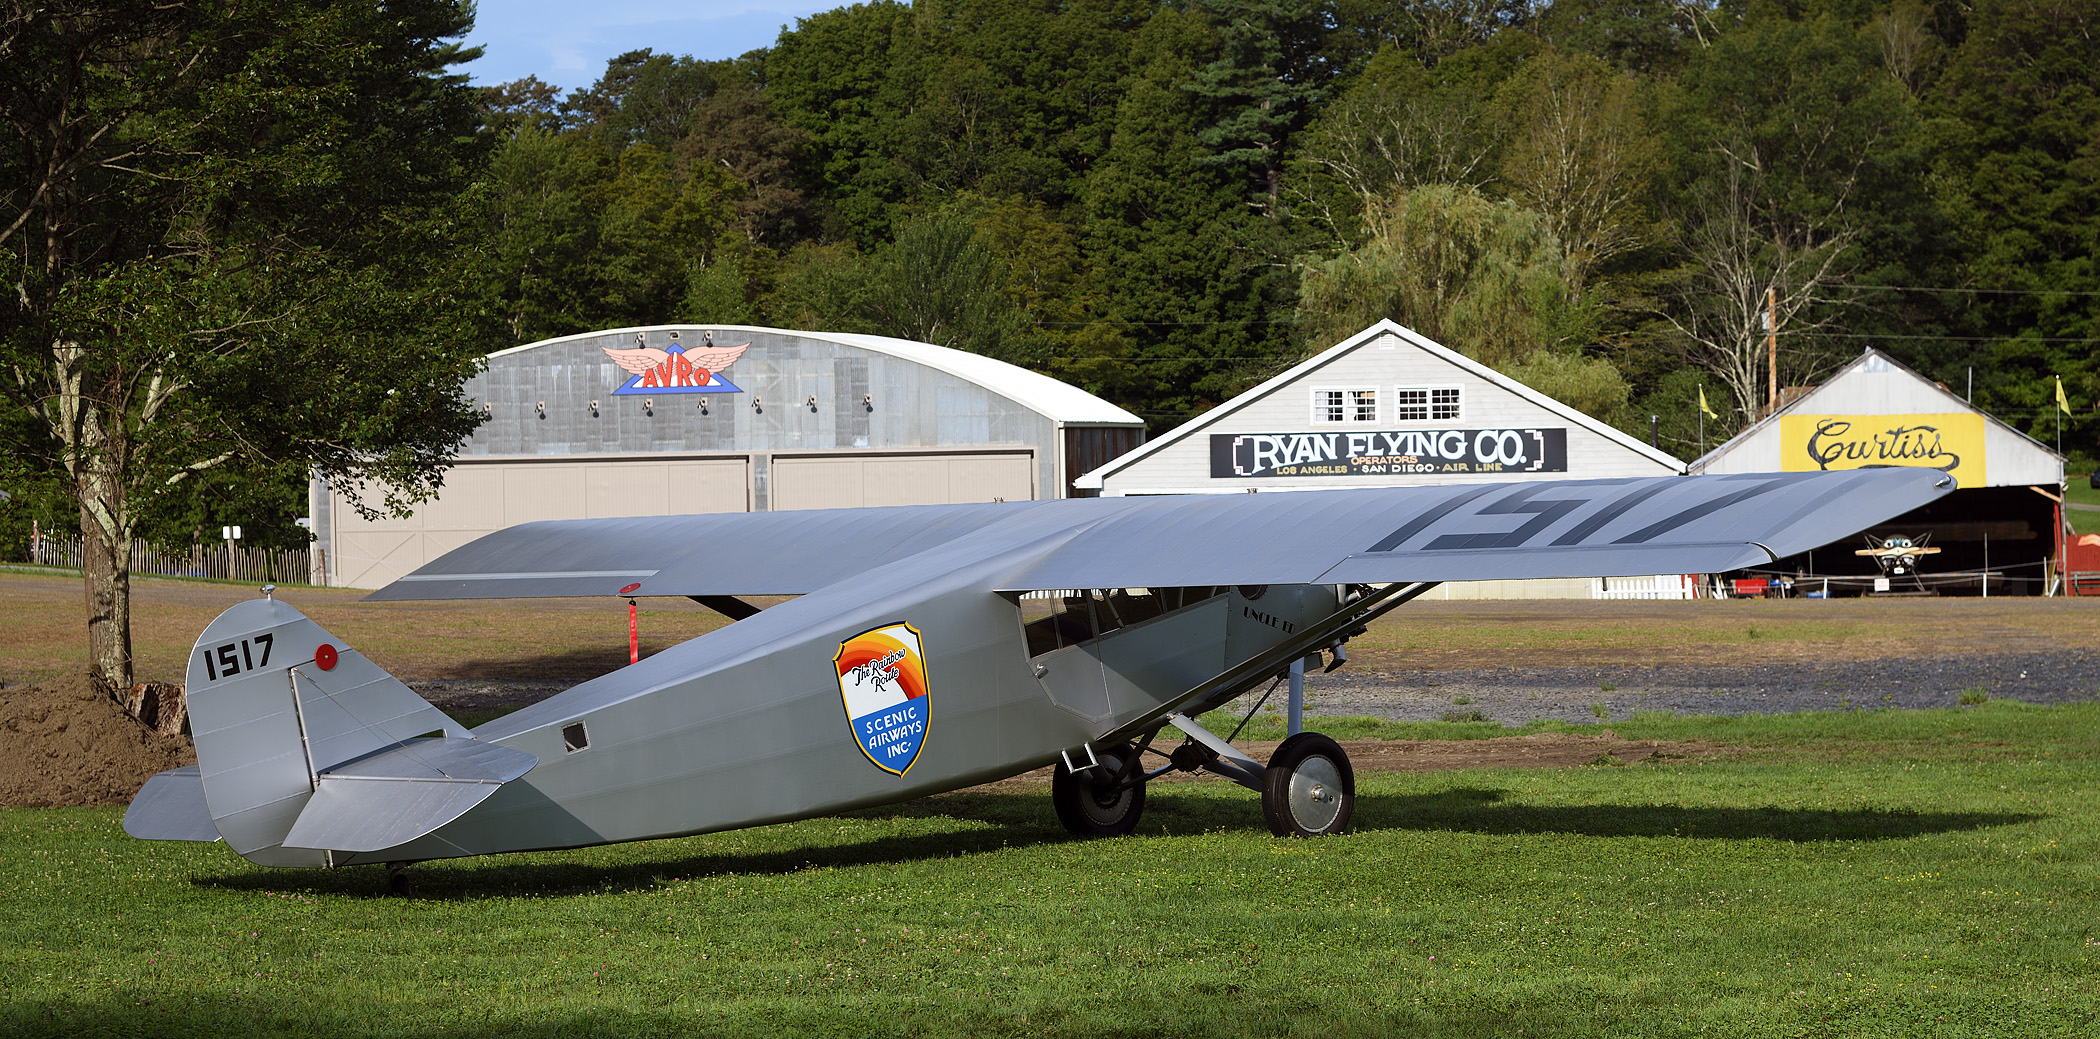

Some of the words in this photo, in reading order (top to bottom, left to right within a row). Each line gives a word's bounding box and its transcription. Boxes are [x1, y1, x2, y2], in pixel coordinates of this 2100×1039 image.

[642, 352, 711, 388] AVRO
[1252, 434, 1340, 474] RYAN
[1345, 431, 1468, 460] FLYING
[1474, 429, 1527, 466] CO.
[1350, 456, 1418, 465] OPERATORS
[1807, 418, 1960, 472] Curtiss
[1276, 466, 1297, 475] LOS
[1300, 465, 1348, 474] ANGELES
[1361, 464, 1387, 473] SAN
[1391, 463, 1435, 473] DIEGO
[1442, 463, 1469, 472] AIR
[1475, 462, 1503, 472] LINE
[1365, 471, 1822, 553] 1517
[1243, 606, 1279, 629] UNCLE
[1282, 620, 1296, 634] ED
[203, 632, 273, 681] 1517
[851, 664, 871, 686] The
[869, 648, 906, 677] Rainbow
[870, 667, 899, 692] Route
[866, 706, 917, 734] SCENIC
[869, 720, 922, 749] AIRWAYS
